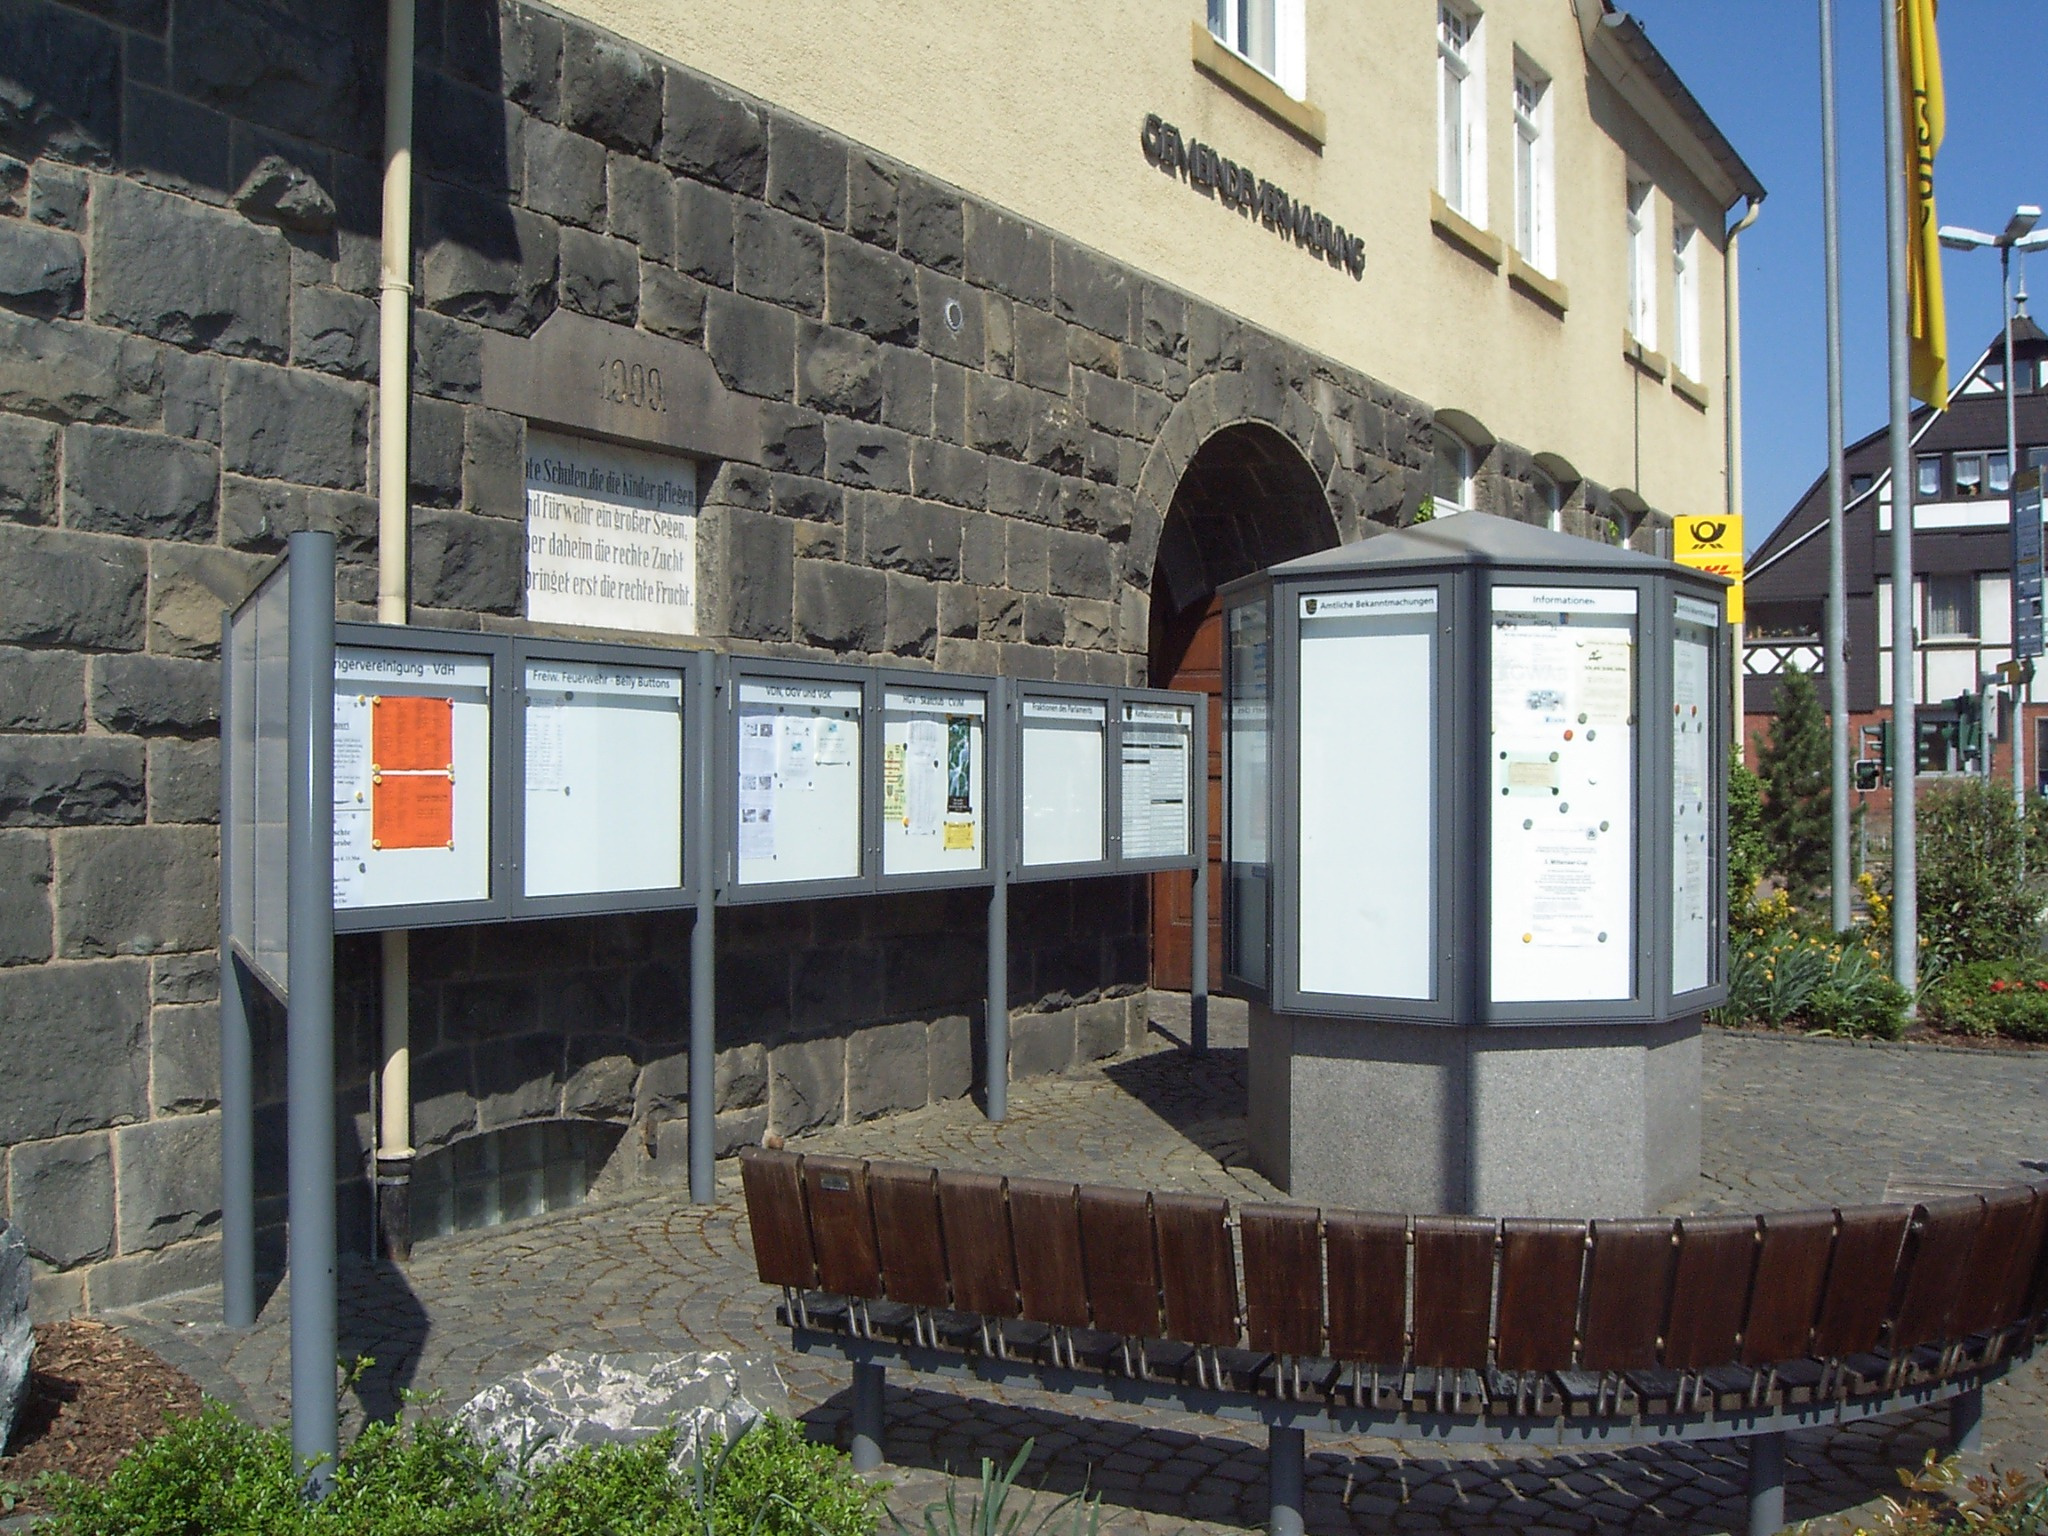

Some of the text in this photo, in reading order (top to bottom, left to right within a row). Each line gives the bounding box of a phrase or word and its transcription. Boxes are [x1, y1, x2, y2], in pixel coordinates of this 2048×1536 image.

[1141, 112, 1366, 282] GEMEINDEVERWALTUNG
[590, 467, 604, 491] die
[606, 470, 620, 495] die
[596, 505, 612, 528] ein
[614, 508, 651, 534] großer
[549, 532, 592, 560] daheim
[595, 539, 611, 563] die
[613, 543, 649, 568] rechte
[652, 546, 684, 572] Zucht
[573, 576, 598, 596] erst
[600, 574, 616, 598] die
[618, 578, 654, 602] rechte
[1533, 596, 1596, 605] Informationen
[1320, 598, 1434, 610] Amtliche Bekanntmachungen
[433, 663, 456, 676] VdH
[562, 672, 608, 685] Feuerwehr
[638, 677, 670, 688] Buttons
